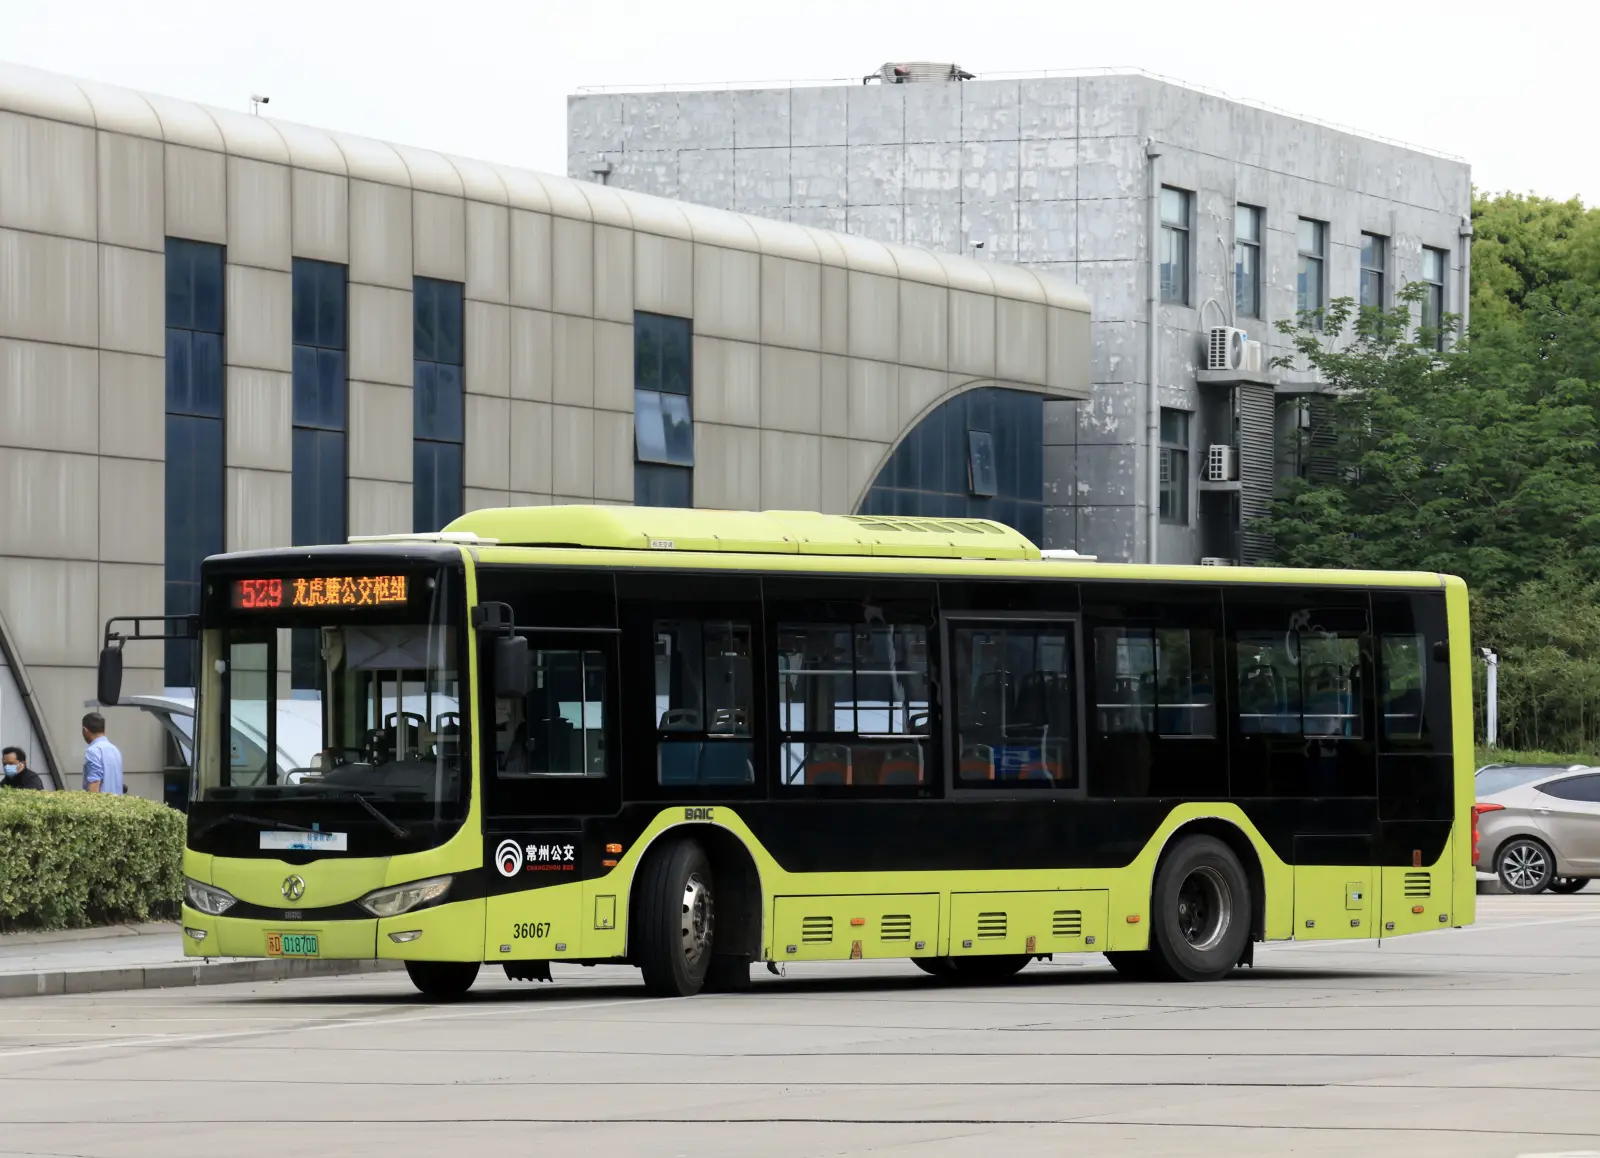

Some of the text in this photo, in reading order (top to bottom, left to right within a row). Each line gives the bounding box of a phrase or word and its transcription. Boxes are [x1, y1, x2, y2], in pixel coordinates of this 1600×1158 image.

[242, 576, 407, 608] 529 龙虎塘公交枢纽
[685, 807, 714, 820] BAIC
[525, 844, 575, 862] 常州公交
[513, 922, 551, 939] 36067
